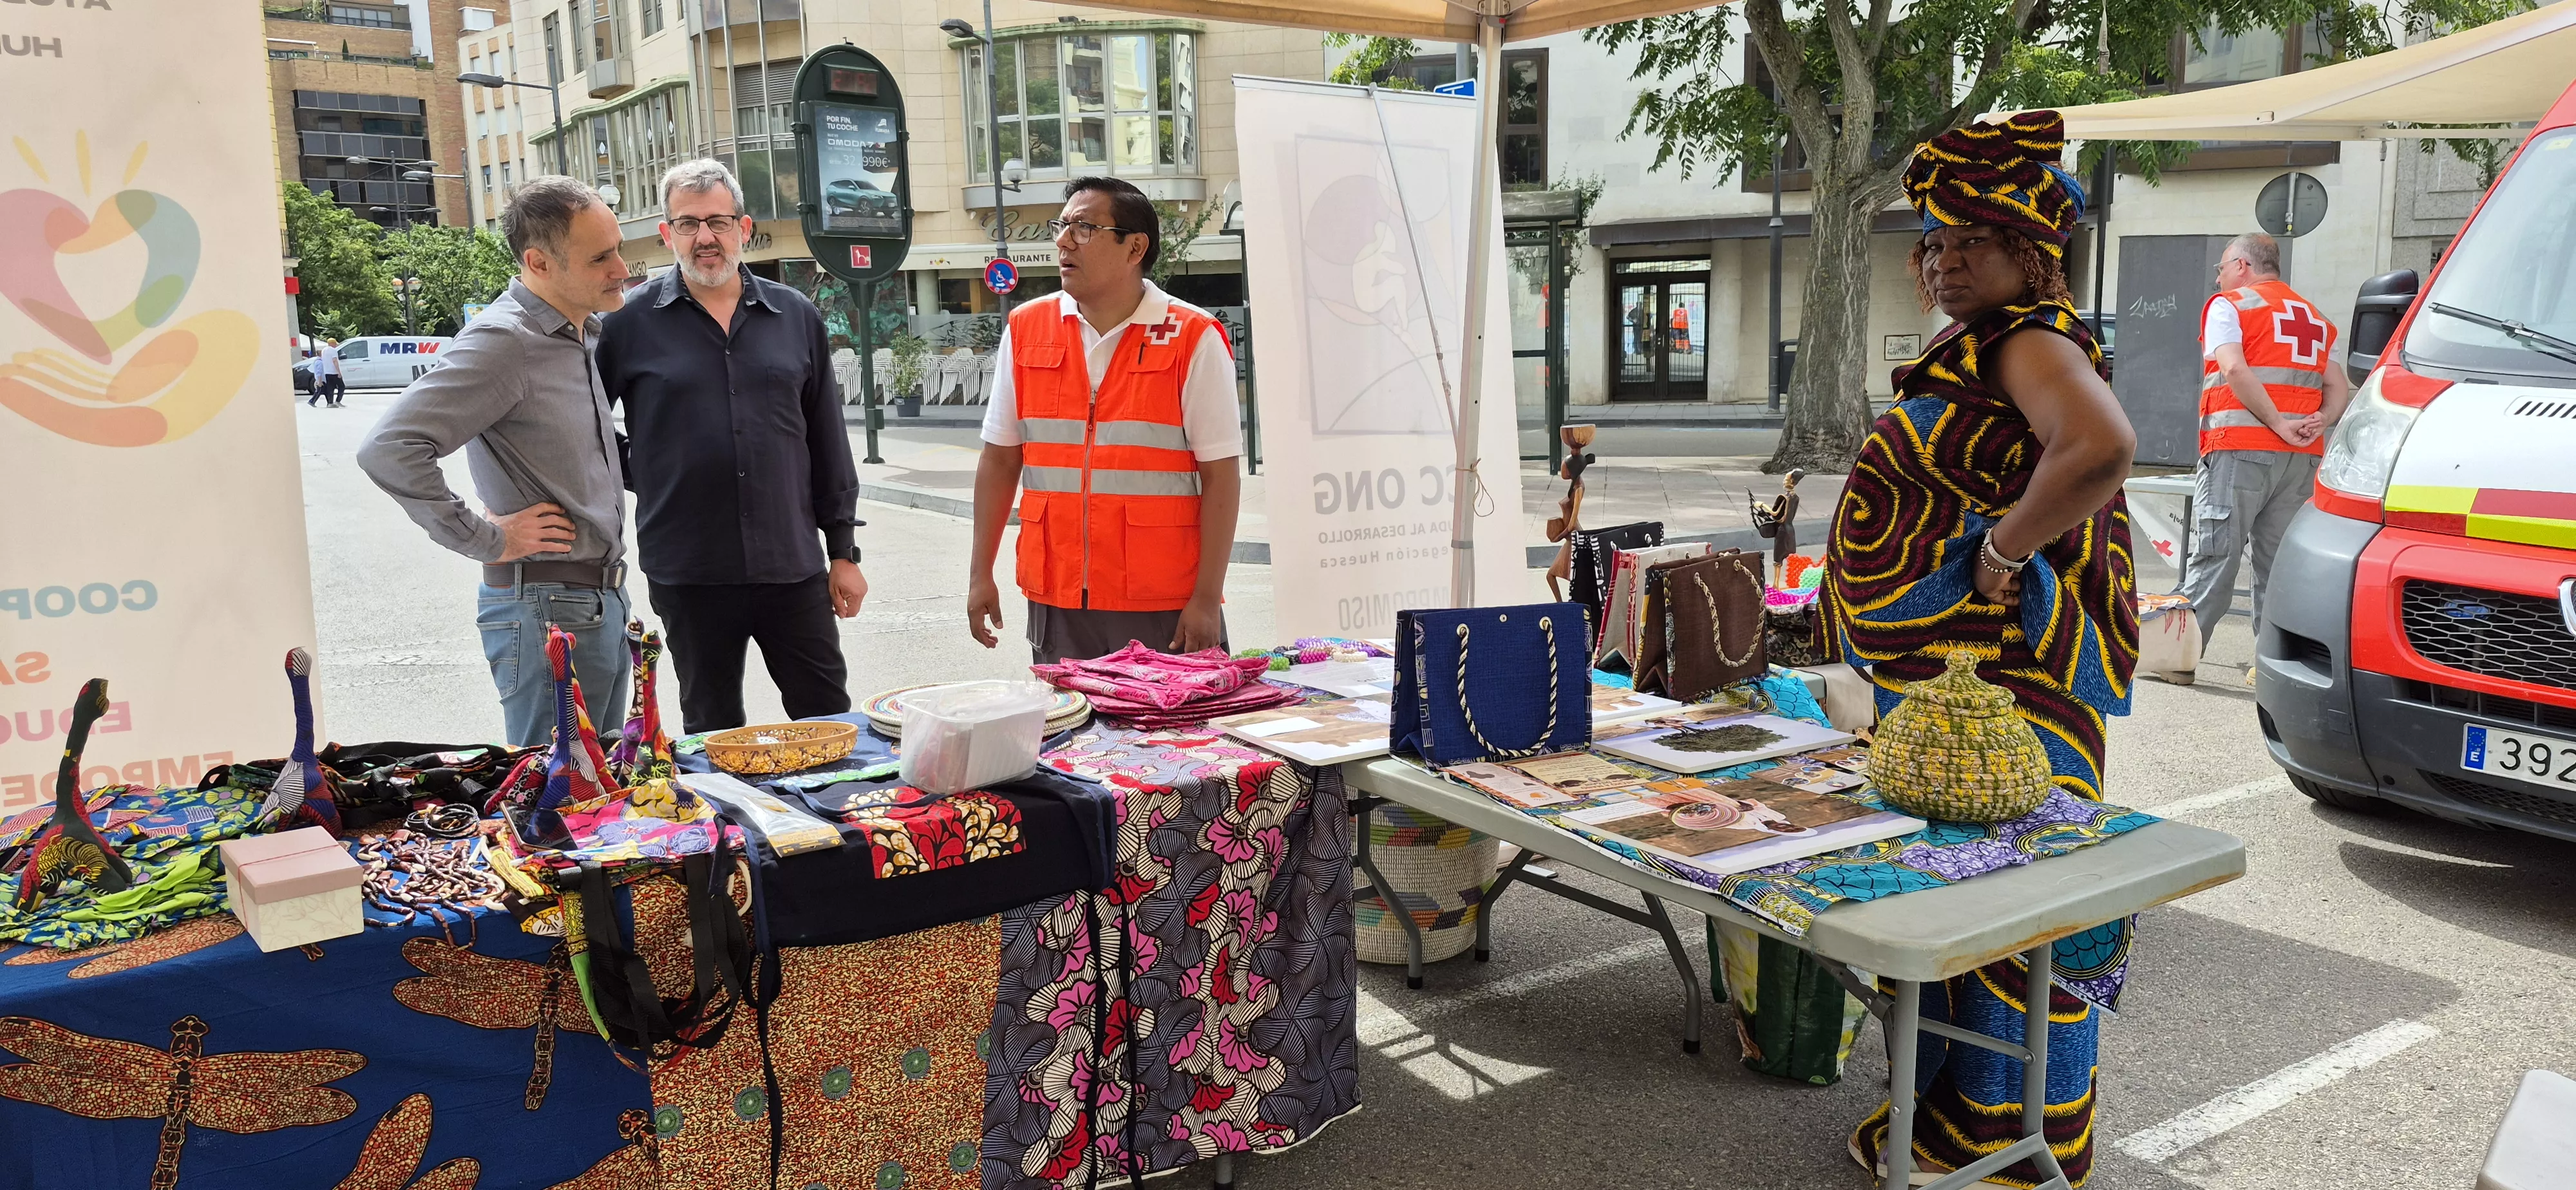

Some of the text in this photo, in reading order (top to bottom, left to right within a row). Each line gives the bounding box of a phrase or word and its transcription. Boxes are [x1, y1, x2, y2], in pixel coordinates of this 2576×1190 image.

[828, 138, 866, 147] OMODA
[985, 254, 1051, 263] REAURANTE
[626, 261, 647, 277] ANGO
[380, 342, 440, 354] MRW
[2470, 737, 2576, 784] E 392
